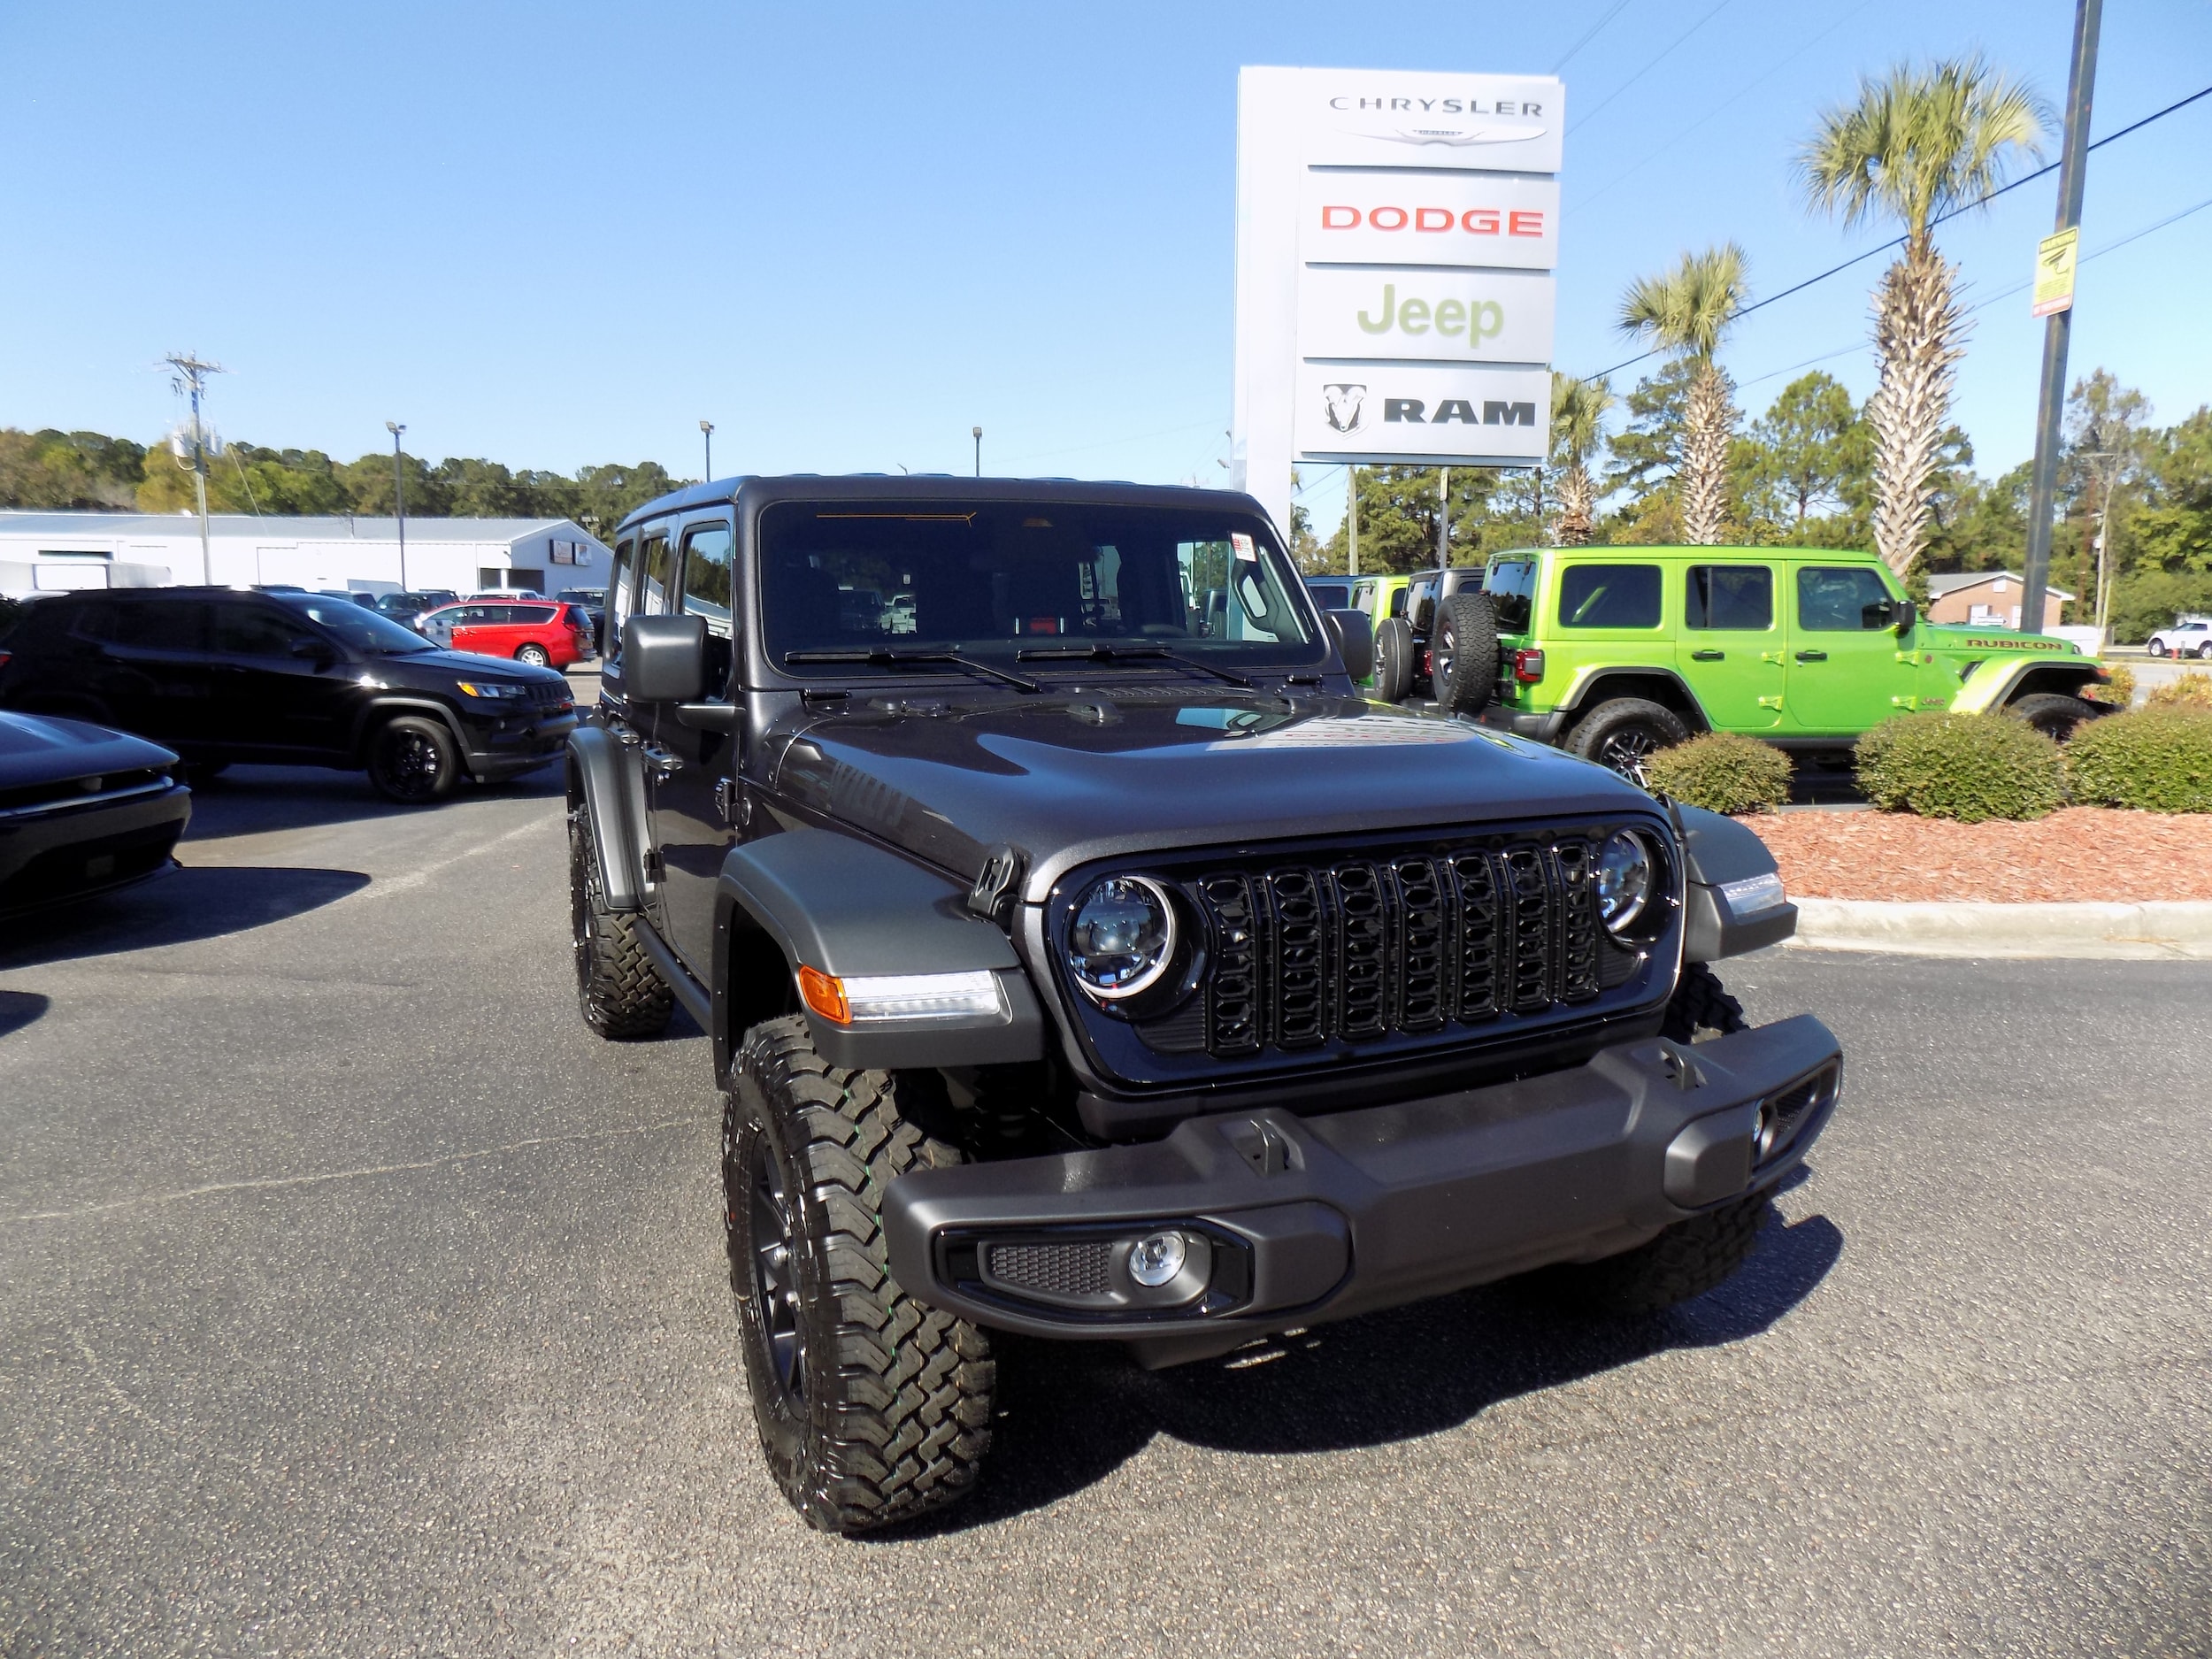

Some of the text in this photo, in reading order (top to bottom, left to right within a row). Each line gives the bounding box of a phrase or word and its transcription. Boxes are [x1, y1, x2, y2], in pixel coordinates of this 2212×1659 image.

[1329, 96, 1543, 118] CHRYSLER
[1322, 205, 1544, 238] DODGE
[1357, 283, 1504, 349] Jeep
[1384, 397, 1536, 427] RAM
[1967, 639, 2062, 650] RUBICON
